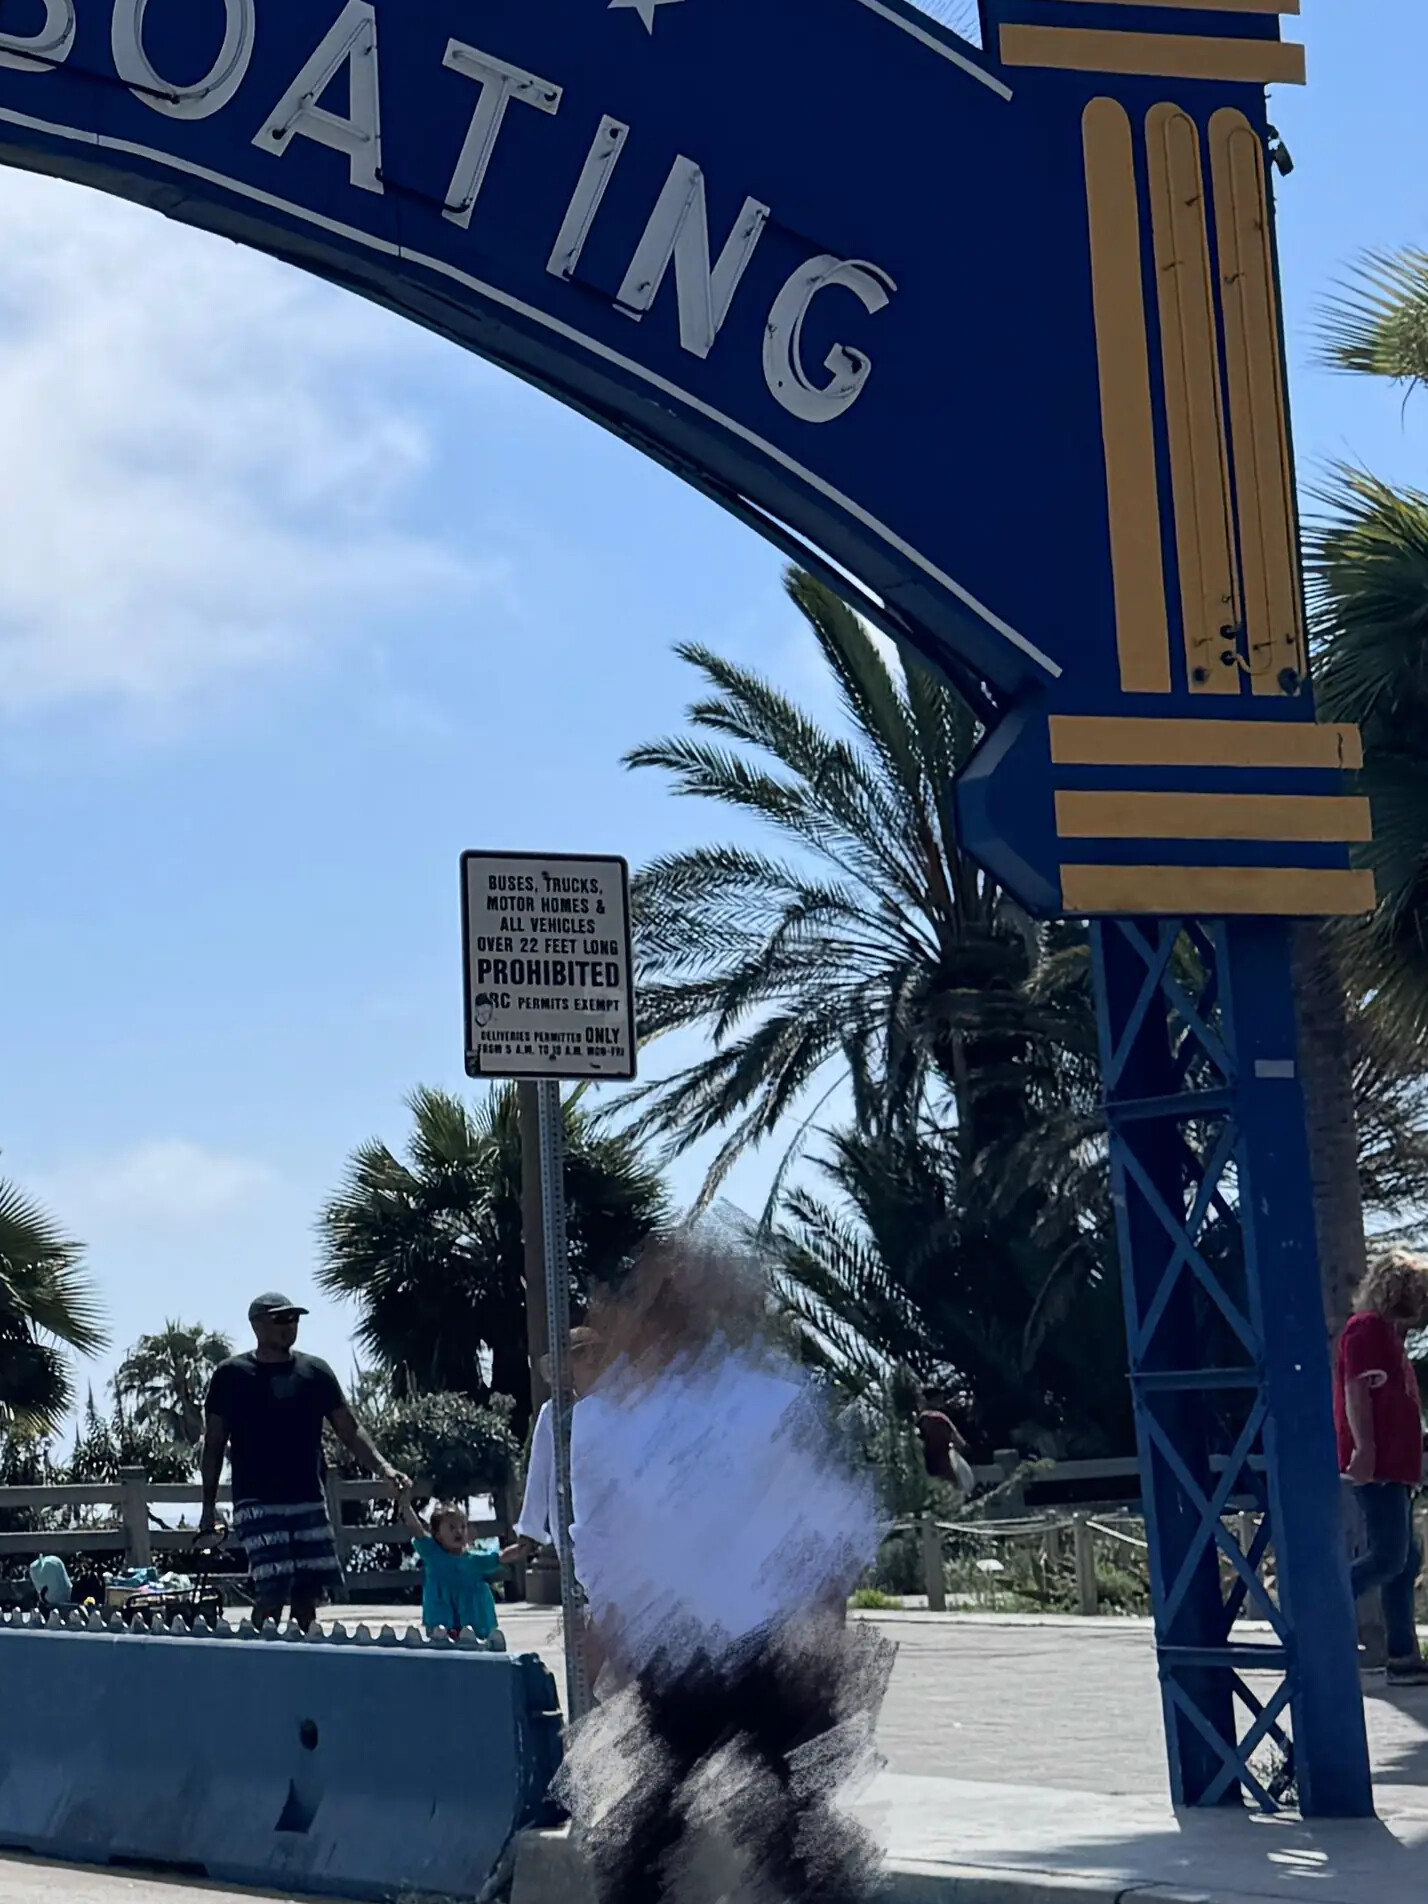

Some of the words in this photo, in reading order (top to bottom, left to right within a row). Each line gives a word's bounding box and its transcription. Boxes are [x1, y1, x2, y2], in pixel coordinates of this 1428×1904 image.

[488, 875, 538, 893] BUSES,
[544, 877, 603, 894] TRUCKS,
[486, 896, 534, 911] MOTOR
[541, 898, 589, 914] HOMES
[596, 899, 606, 914] &
[500, 917, 524, 932] ALL
[531, 918, 596, 934] VEHICLES
[477, 937, 513, 952] OVER
[520, 938, 539, 953] 22
[545, 939, 577, 954] FEET
[583, 940, 619, 955] LONG
[477, 959, 619, 987] PROHIBITED
[518, 997, 569, 1010] PERMITS
[574, 998, 620, 1011] EXEMPT
[481, 1031, 530, 1042] DELIVERIES
[534, 1032, 582, 1043] PERMITTED
[585, 1027, 620, 1044] ONLY
